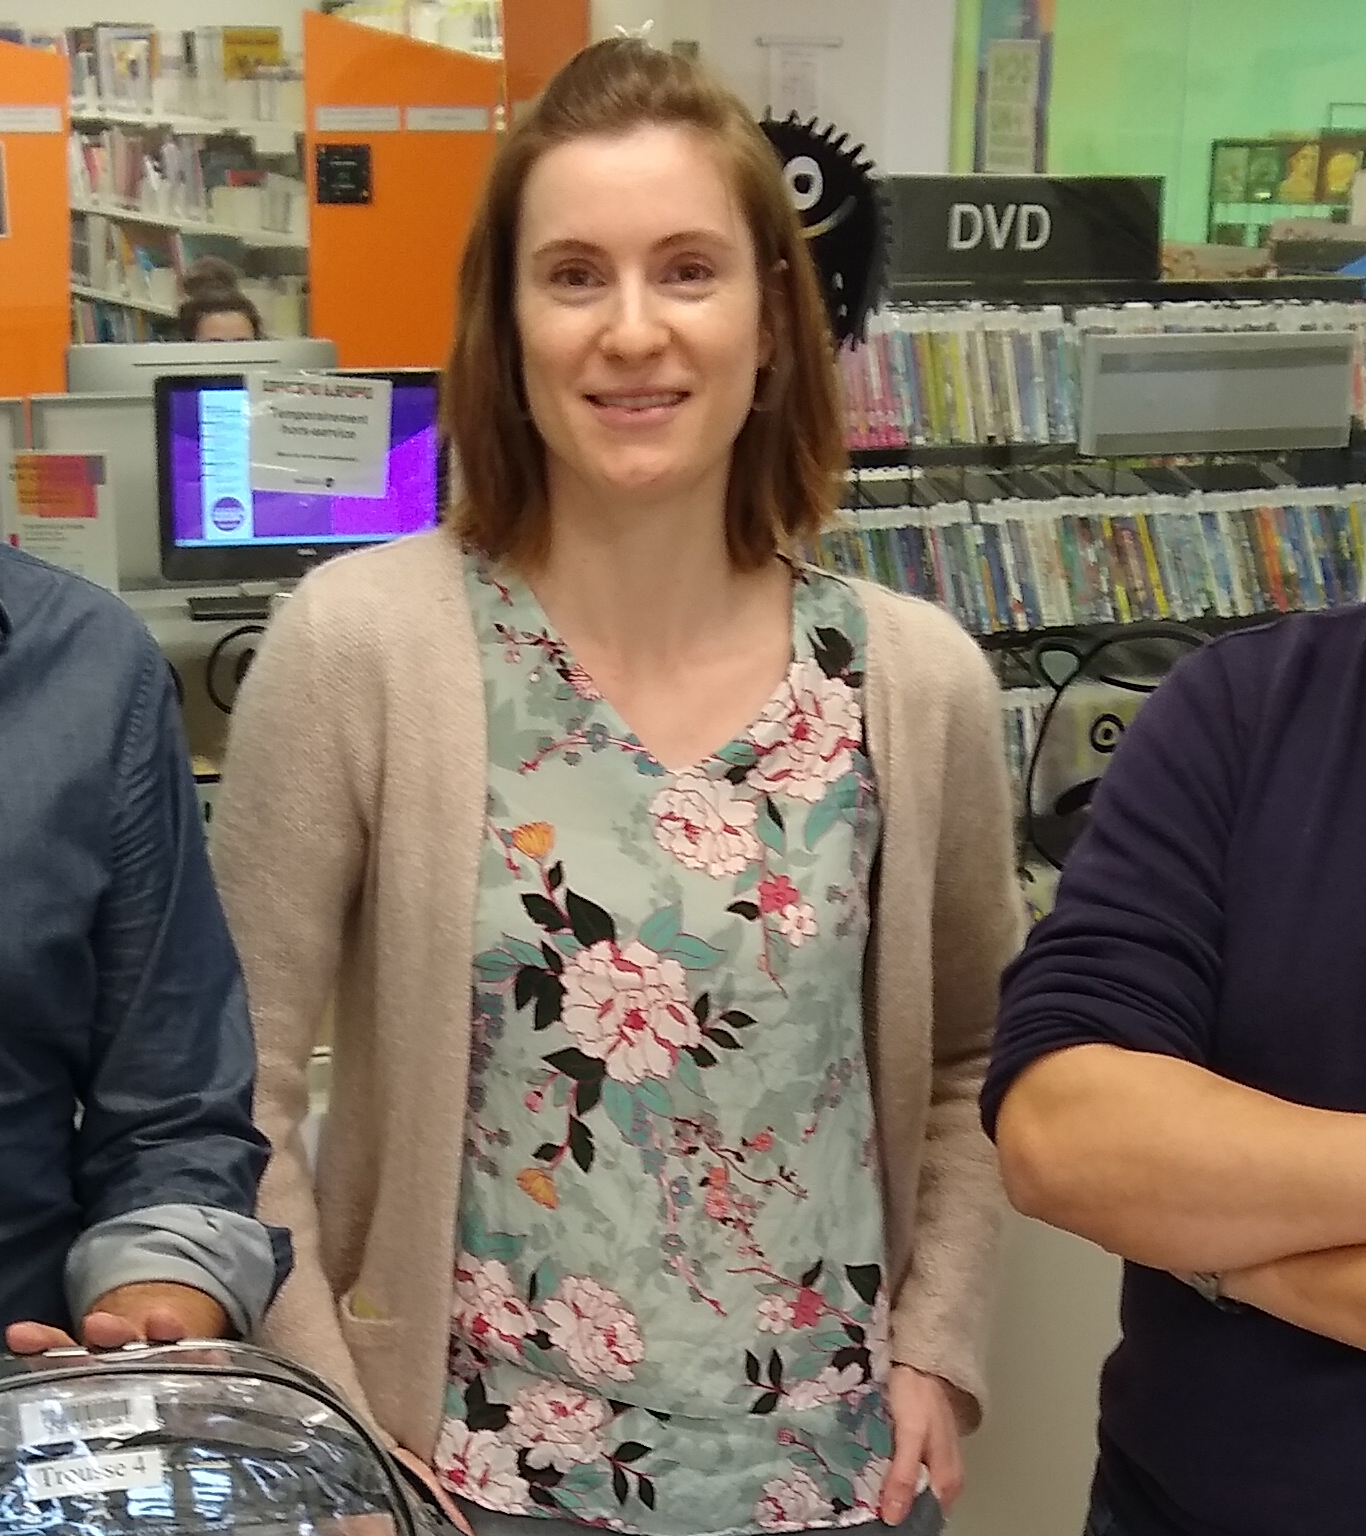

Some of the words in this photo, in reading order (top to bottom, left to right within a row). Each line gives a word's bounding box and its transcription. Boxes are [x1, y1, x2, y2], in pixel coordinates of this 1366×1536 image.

[947, 203, 1051, 250] DVD
[37, 1463, 126, 1487] Trousse
[132, 1455, 146, 1474] 4
